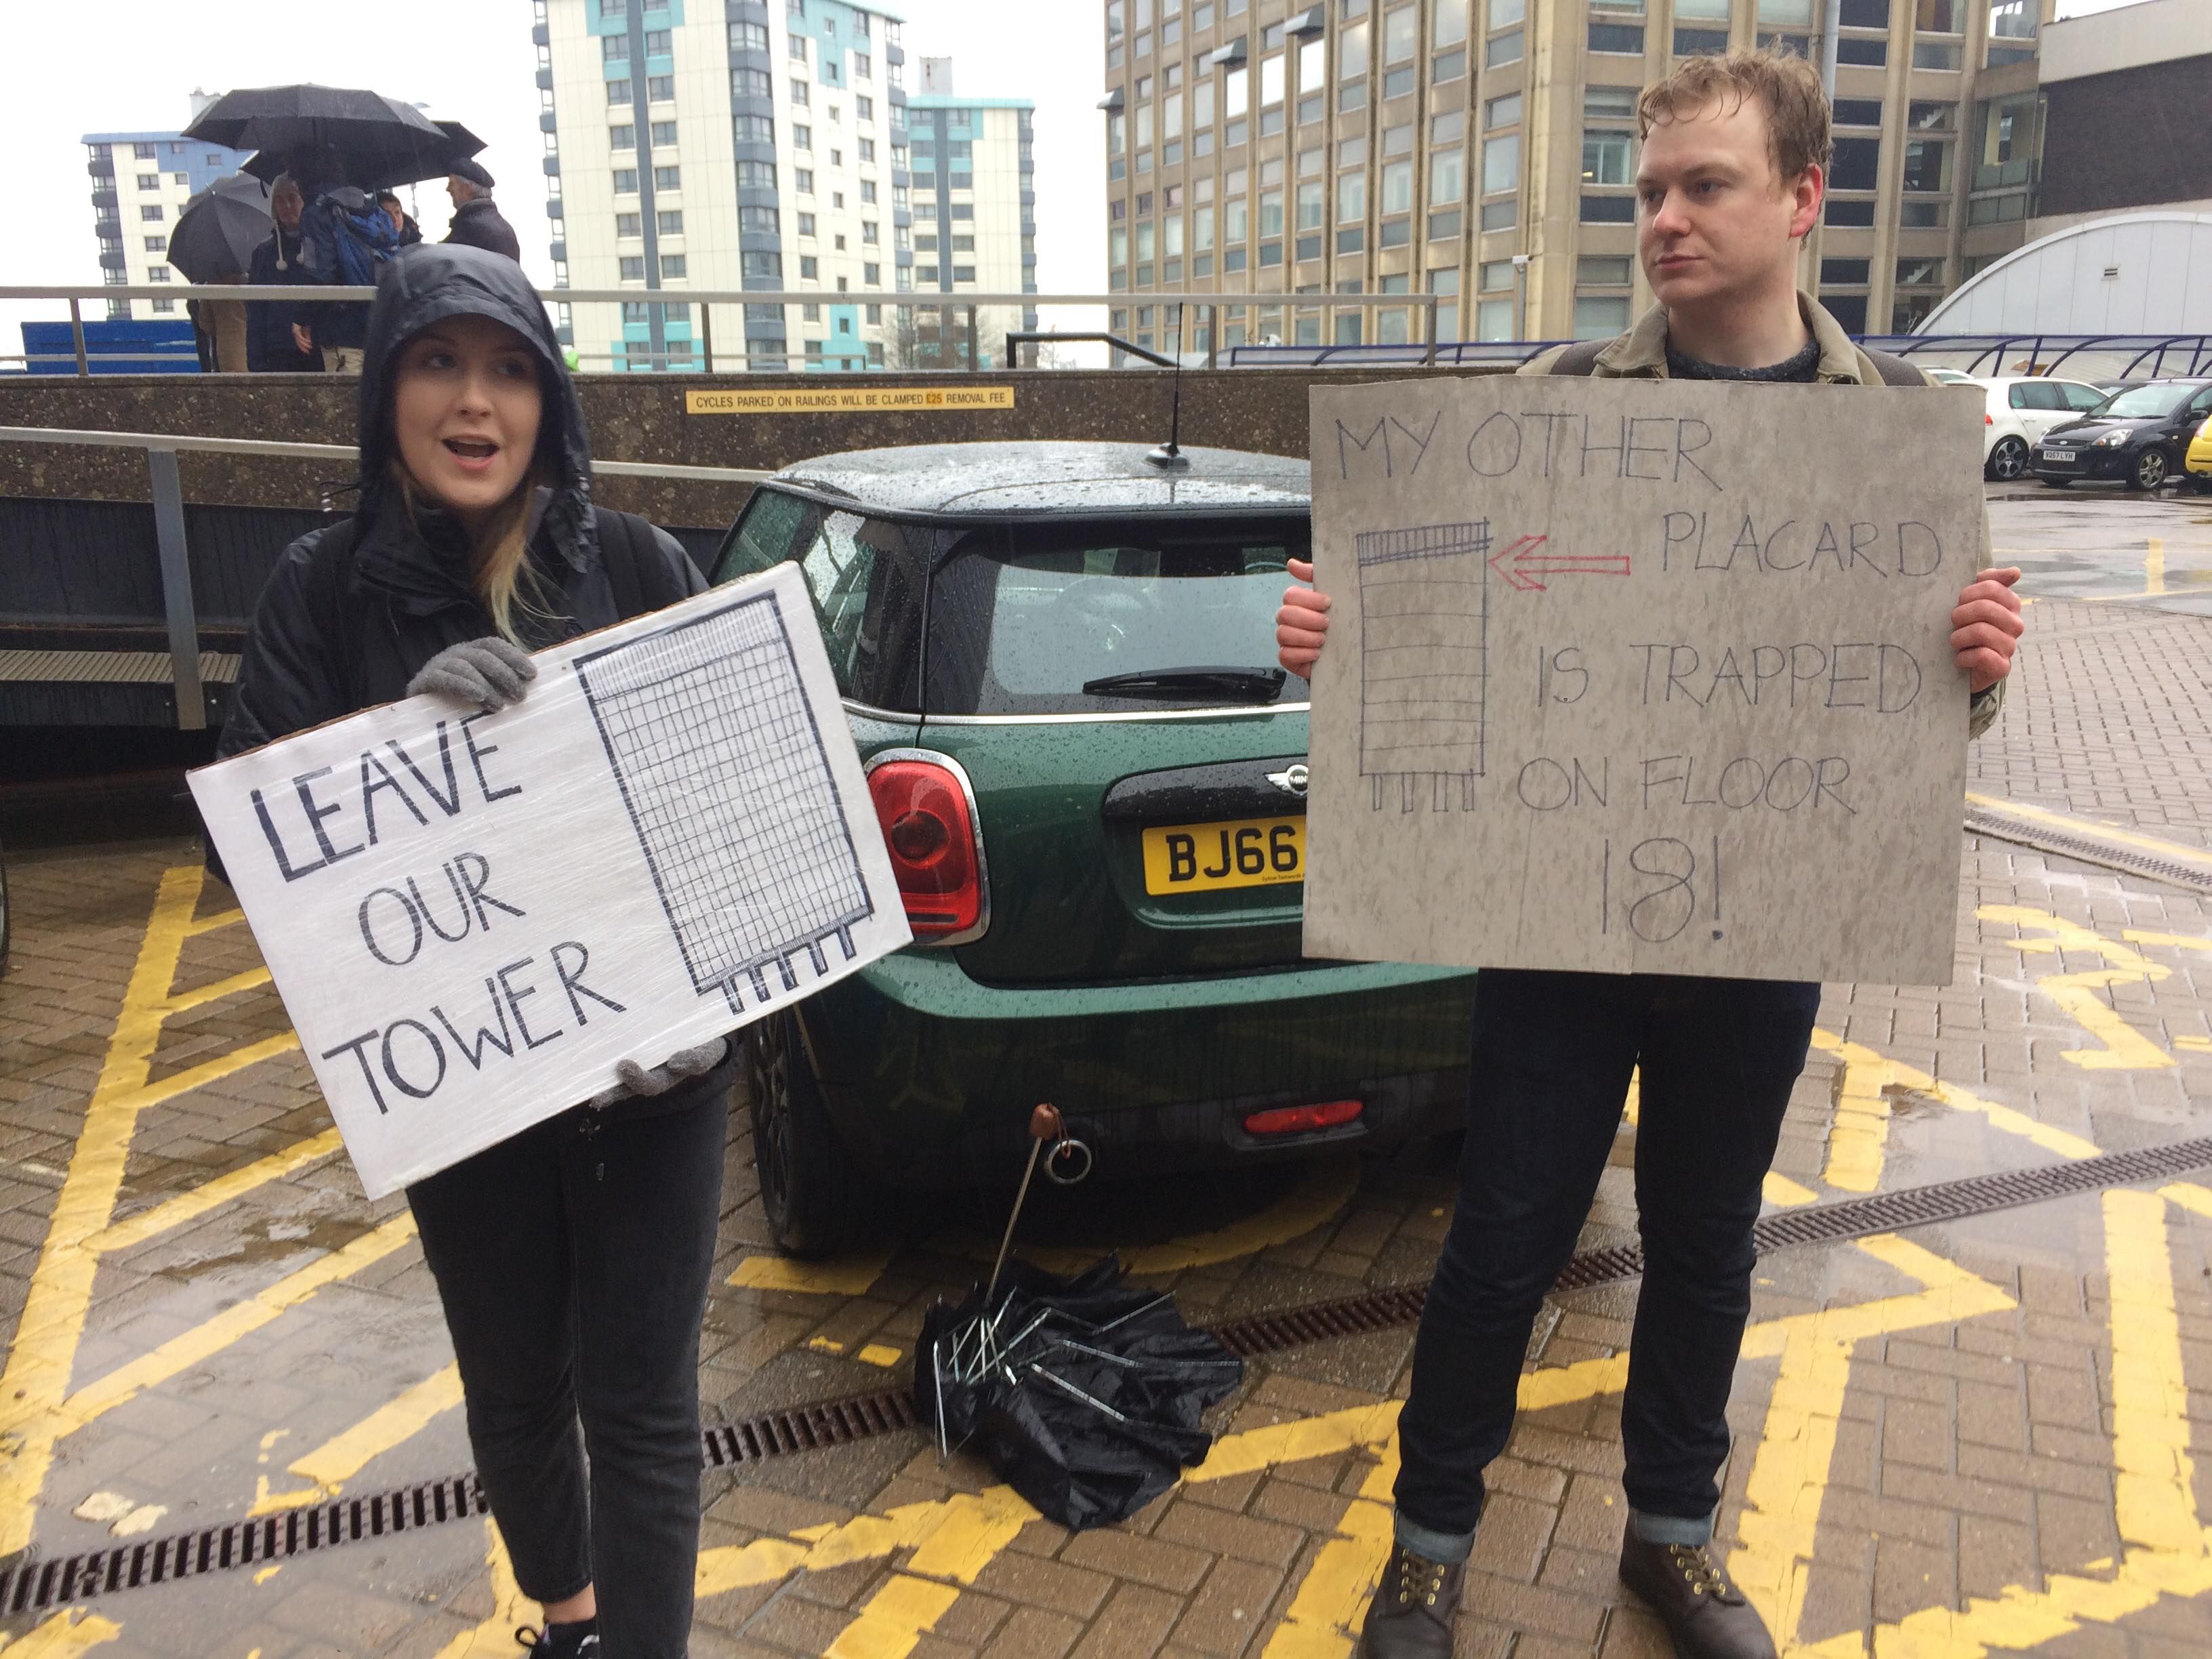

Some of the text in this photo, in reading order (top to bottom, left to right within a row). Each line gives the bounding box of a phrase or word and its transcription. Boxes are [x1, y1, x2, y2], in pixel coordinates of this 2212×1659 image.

[696, 392, 1005, 407] CYCLES PARKED ON RAILINGS WILL BE CLAMPED £25 REMOVAL FEE
[1336, 411, 1723, 491] MY OTHER
[1663, 512, 1942, 578] PLACARD
[1538, 642, 1922, 714] IS TRAPPED
[251, 710, 522, 882] LEAVE
[1290, 775, 1307, 784] MIN
[1517, 755, 1857, 815] ON FLOOR
[357, 852, 526, 966] OUR
[1601, 836, 1723, 942] 18!
[322, 941, 626, 1115] TOWER
